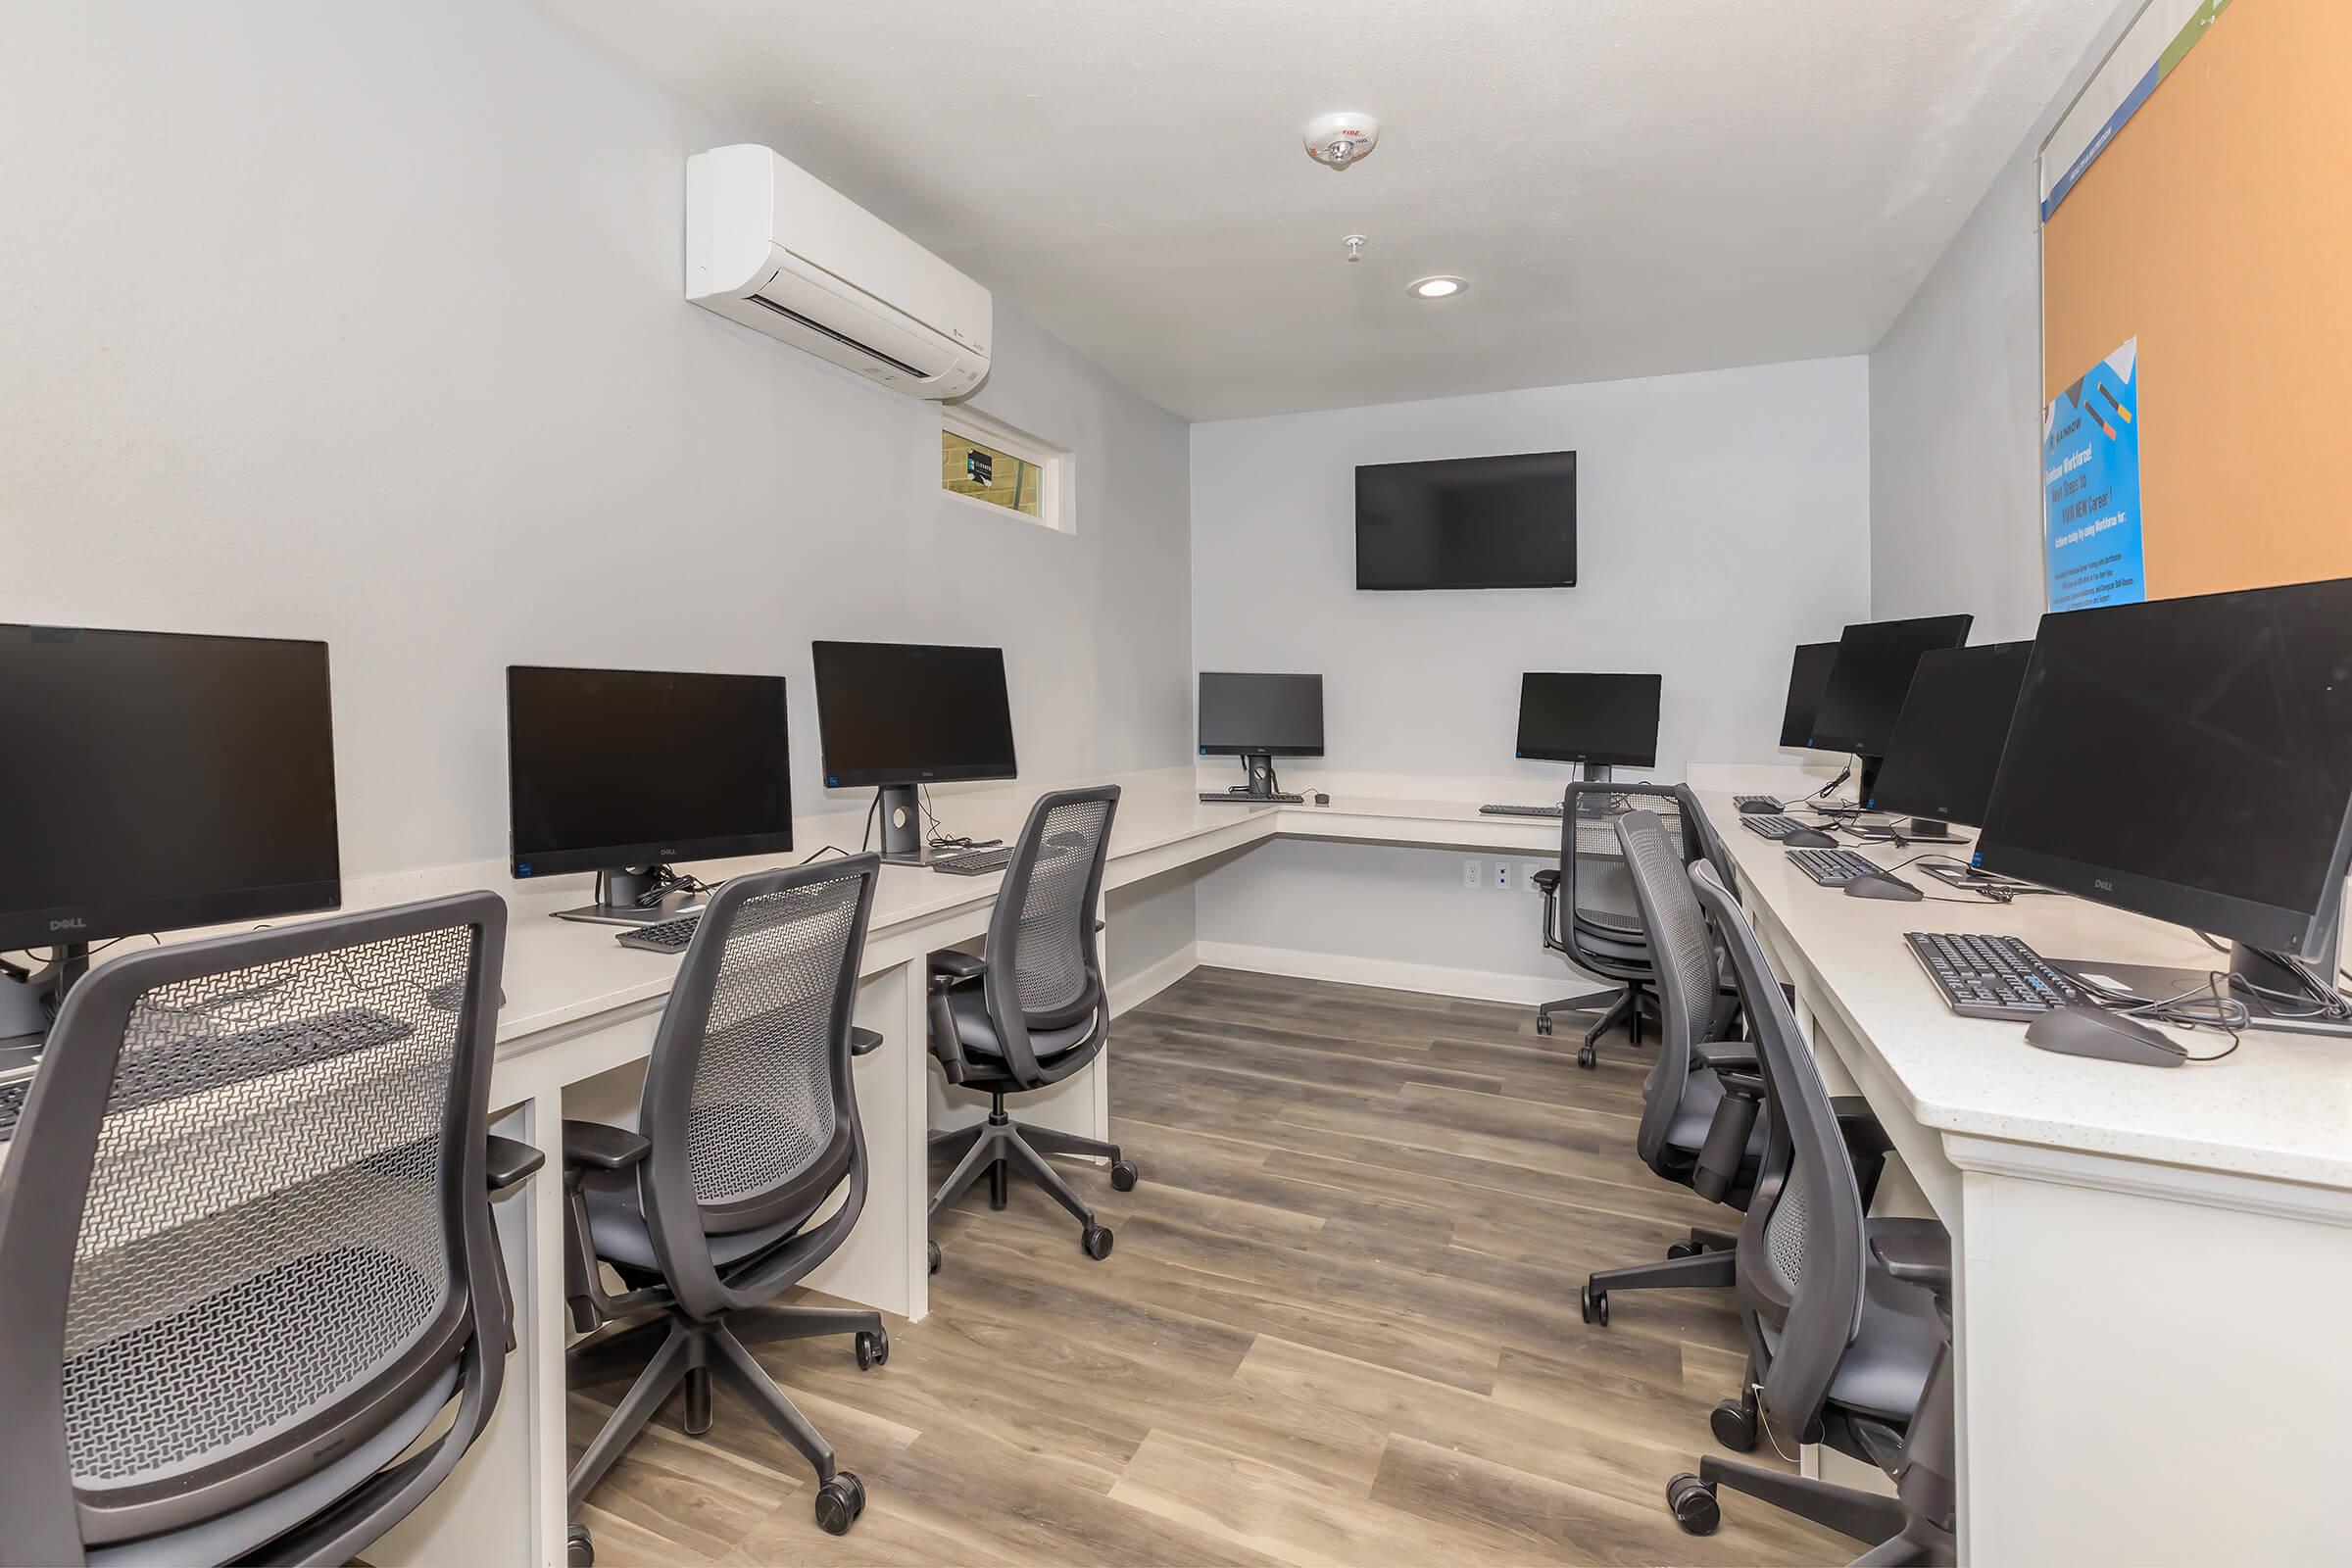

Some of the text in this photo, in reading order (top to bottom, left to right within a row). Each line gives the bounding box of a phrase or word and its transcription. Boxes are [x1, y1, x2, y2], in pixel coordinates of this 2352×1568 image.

[2056, 417, 2082, 442] RAINBOW
[2080, 474, 2086, 489] to
[2062, 504, 2075, 524] YOUR
[2076, 499, 2088, 518] NEW
[2088, 493, 2108, 513] Career
[2094, 878, 2114, 892] DELL
[49, 917, 87, 931] DELL
